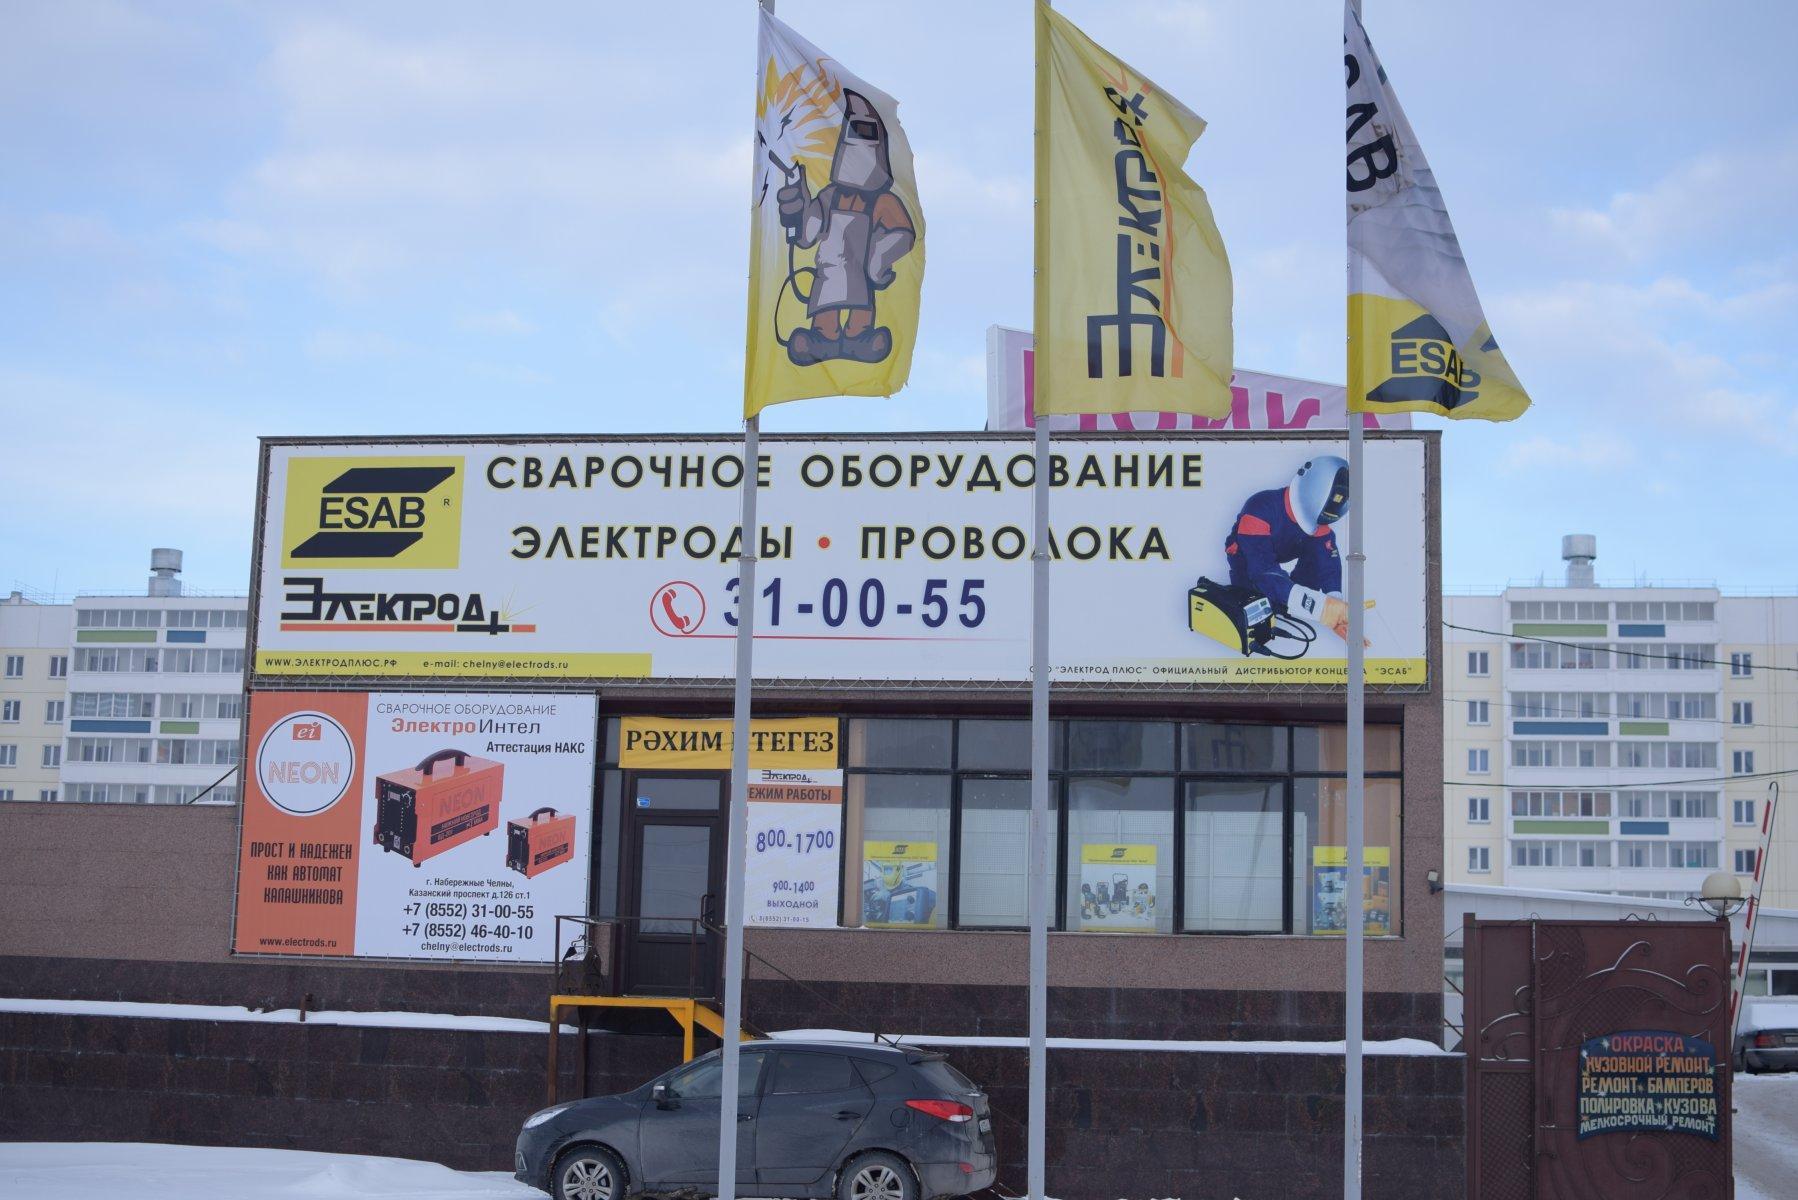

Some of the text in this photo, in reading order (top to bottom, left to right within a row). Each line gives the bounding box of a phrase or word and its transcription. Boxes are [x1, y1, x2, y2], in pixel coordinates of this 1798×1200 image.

[486, 454, 1202, 492] СВАРОЧНОЕ ОБОРУДОВАНИЕ
[319, 496, 426, 529] ESAB
[511, 526, 792, 563] ЭЛЕКТРОДЫ
[860, 525, 1172, 560] ПРОВОЛОКА
[723, 577, 986, 628] 31-00-55
[423, 659, 569, 671] e-mail: chelny@electrods.ru
[1152, 665, 1228, 675] ОФИЦИАЛЬНЫЙ
[1235, 667, 1313, 676] ДИСТРИБЬЮТОР
[376, 703, 558, 716] СВАРОЧНОЕ ОБОРУДОВАНИЕ
[486, 741, 586, 755] Аттестация НАКС
[626, 730, 834, 753] РӘХИМ ТЕГЕЗ
[267, 760, 341, 785] NEON
[748, 787, 832, 801] ЕЖИМ РАБОТЫ
[250, 842, 353, 860] ПРОСТ И НАДЕЖЕН
[267, 865, 344, 882] КАК АВТОМАТ
[434, 878, 485, 888] Набережные
[487, 879, 514, 888] Челны,
[409, 888, 451, 898] Казанский
[453, 890, 490, 899] проспект
[403, 902, 534, 919] +7 (8552) 31-00-55
[767, 899, 819, 909] ВЫХОДНОЙ
[402, 922, 533, 940] +7 (8552) 46-40-10
[259, 937, 337, 948] www.electrods.ru
[421, 941, 513, 953] chelny@electrods.ru
[1611, 1036, 1685, 1053] ОКРАСКА
[1656, 1056, 1710, 1074] РЕМОНТ
[1582, 1077, 1714, 1094] РЕМОНТ БАМПЕРОВ
[1580, 1097, 1717, 1115] ПОЛИРОВКА КУЗОВА
[1580, 1113, 1716, 1135] МЕЛКОСРОЧНЫЙ РЕМОНТ
